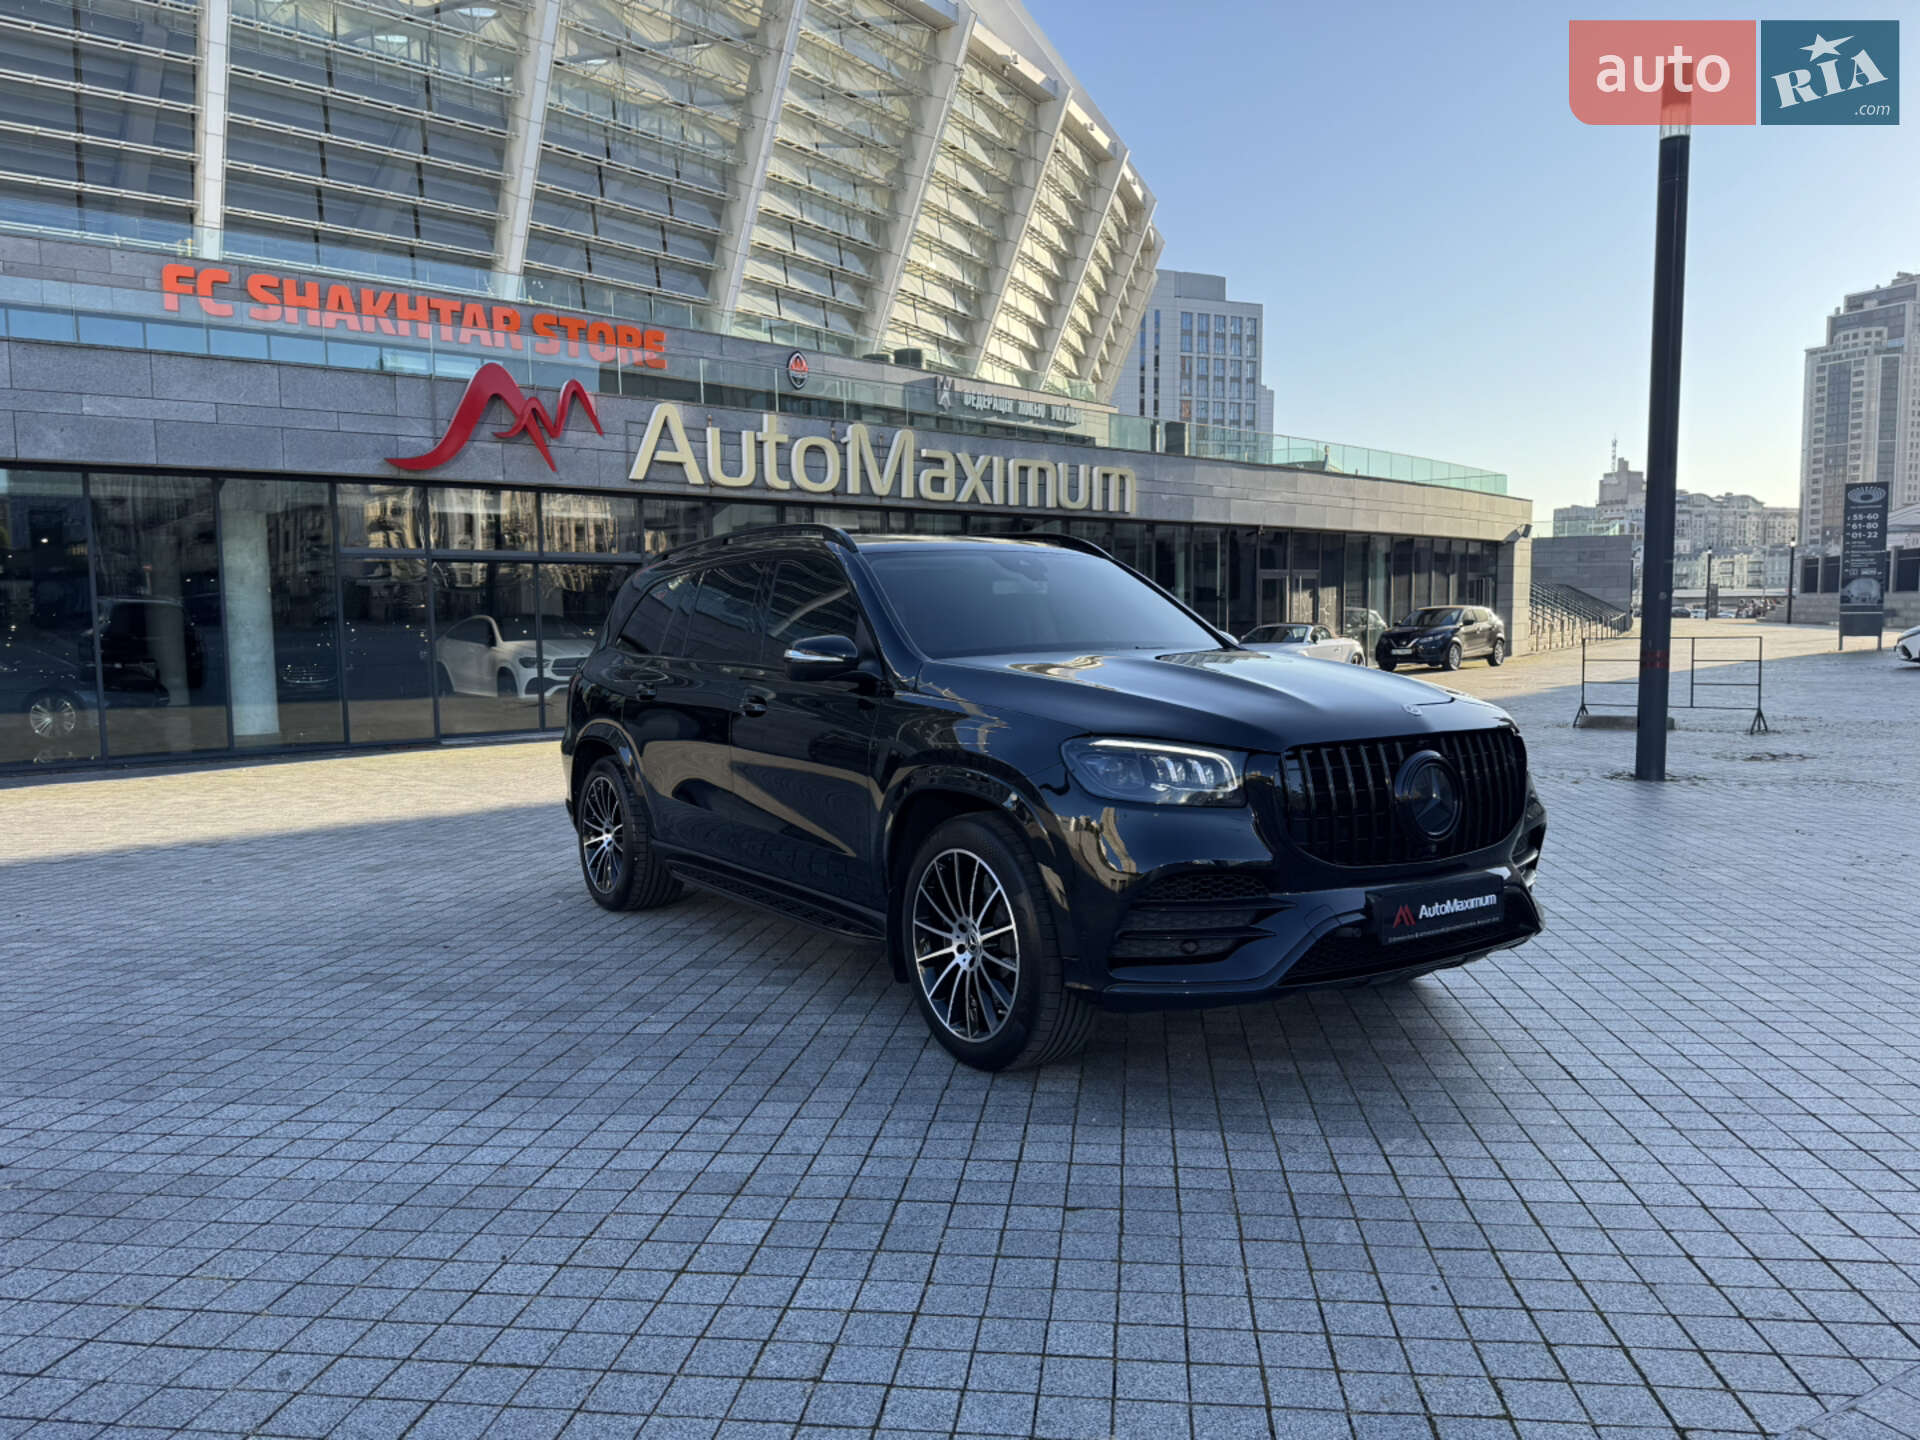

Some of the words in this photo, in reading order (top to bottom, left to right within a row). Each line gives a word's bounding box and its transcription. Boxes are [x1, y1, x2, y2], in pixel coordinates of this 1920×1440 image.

[161, 263, 234, 317] FC
[246, 273, 523, 351] SHAKHTAR
[532, 313, 668, 369] STORE
[628, 402, 1136, 513] AutoMaximum
[1418, 894, 1497, 920] AutoMaximum
